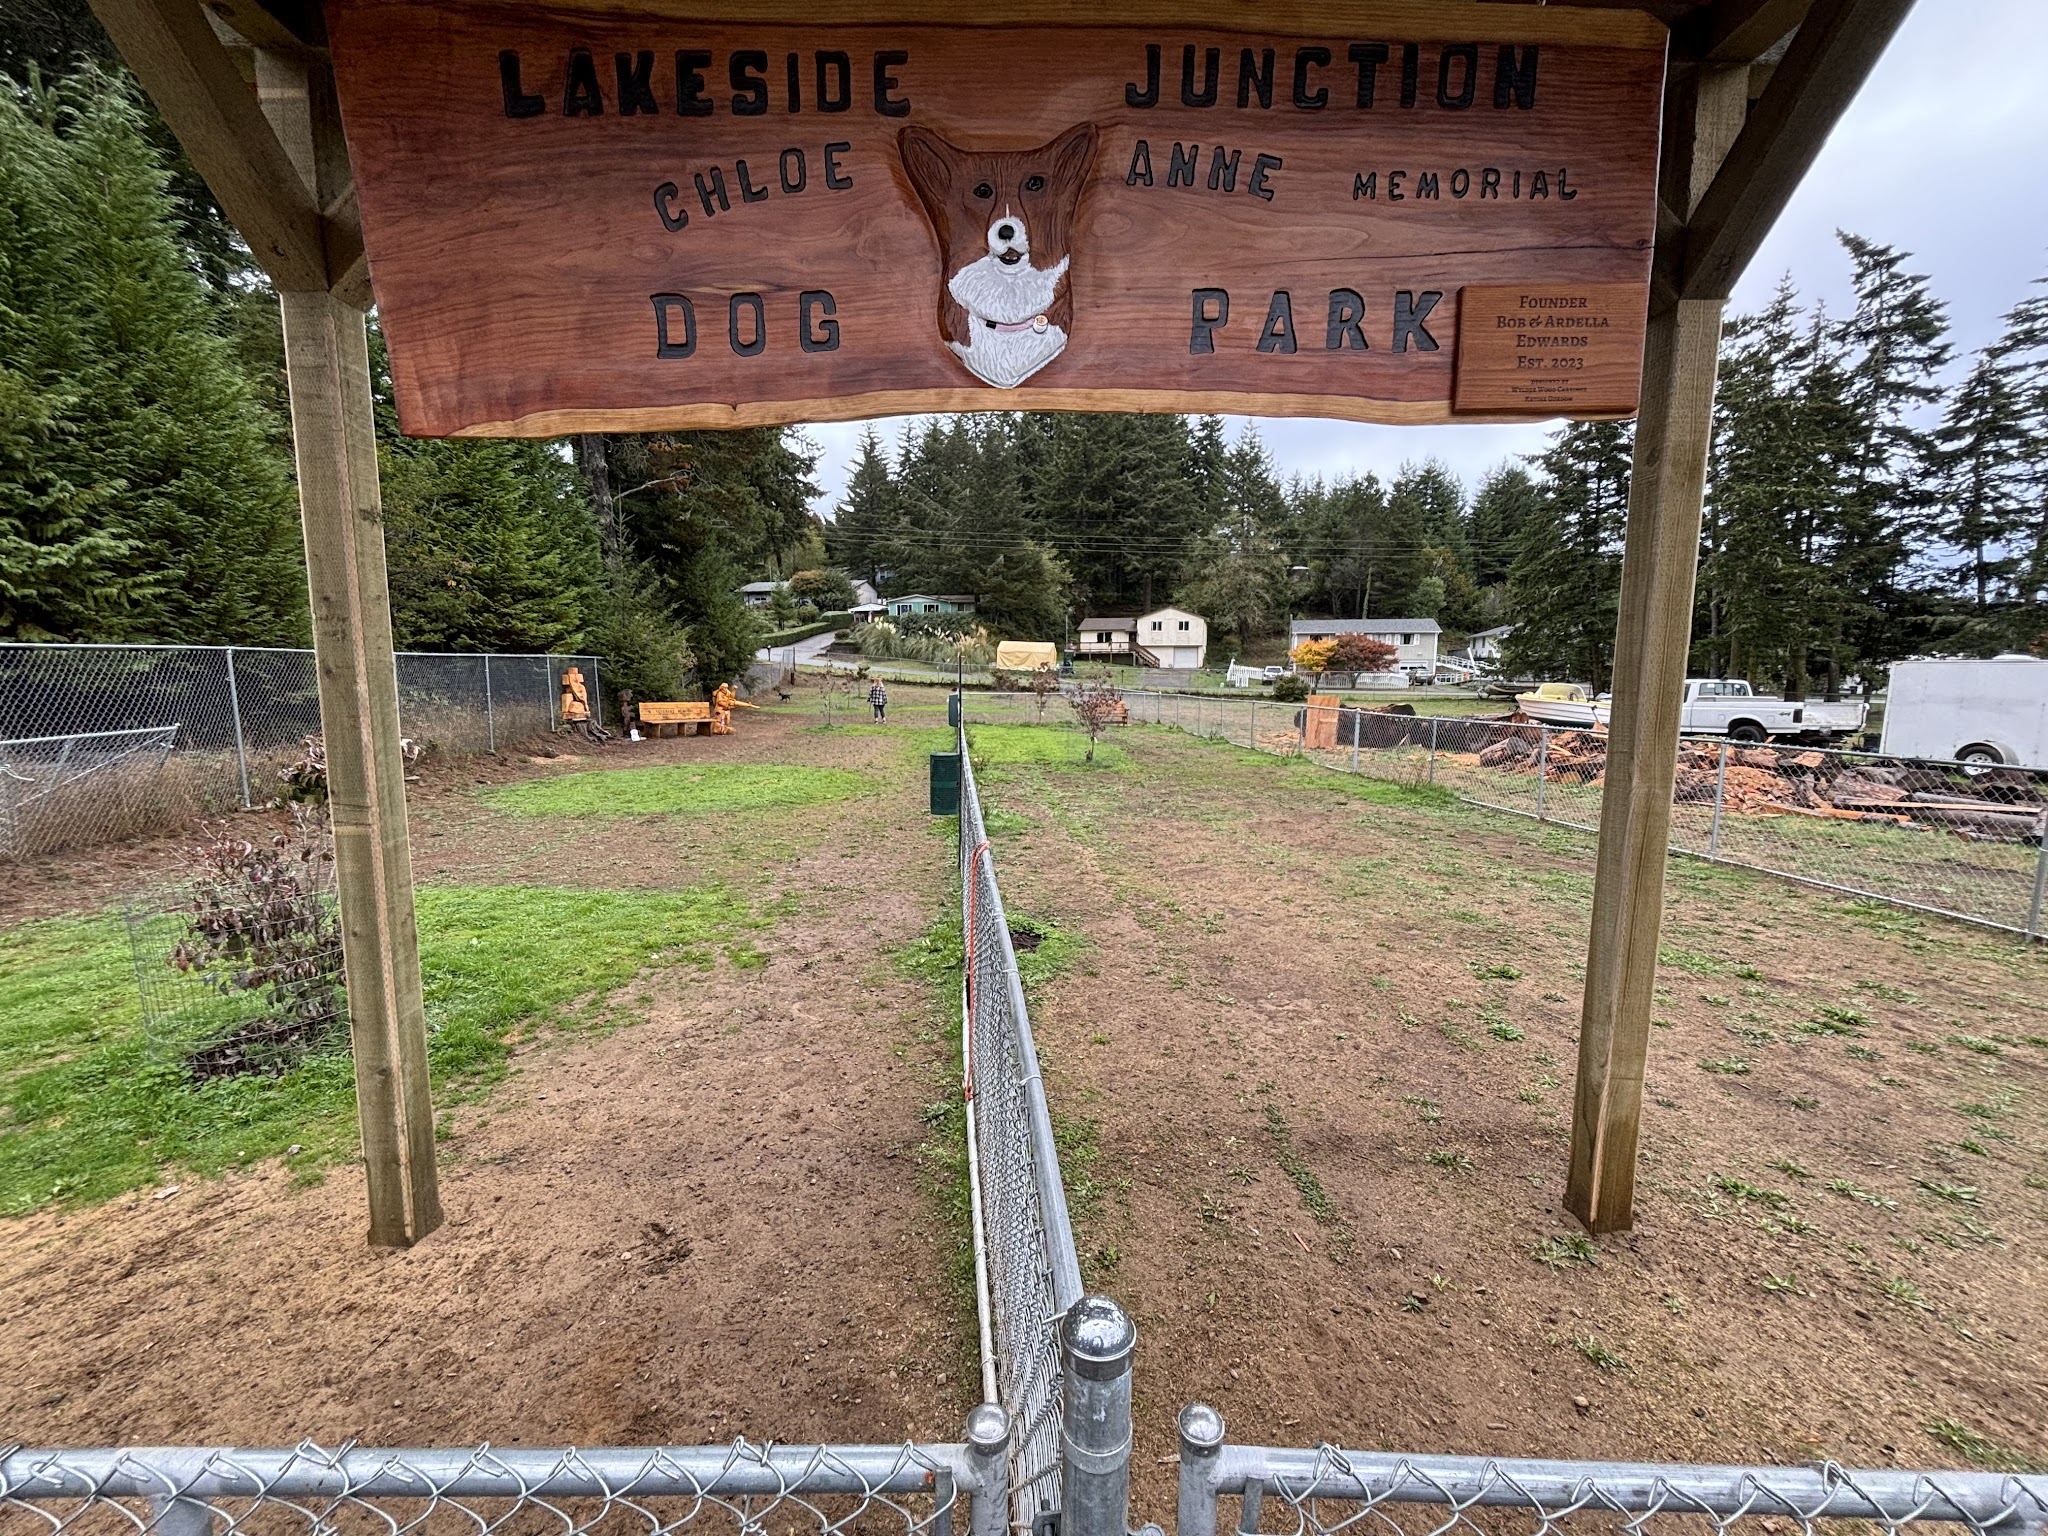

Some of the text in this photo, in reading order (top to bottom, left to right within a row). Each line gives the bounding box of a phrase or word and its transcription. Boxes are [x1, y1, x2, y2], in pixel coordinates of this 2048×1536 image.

[499, 43, 1539, 118] LAKESIDE JUNCTION
[653, 139, 1578, 232] CHLOE ANNE MEMORIAL
[1519, 295, 1588, 308] FOUNDER
[650, 287, 1443, 359] DOG PARK
[1496, 315, 1610, 328] BOB & ARDELLA
[1516, 334, 1588, 347] EDWARDS
[1517, 355, 1584, 370] EST. 2023
